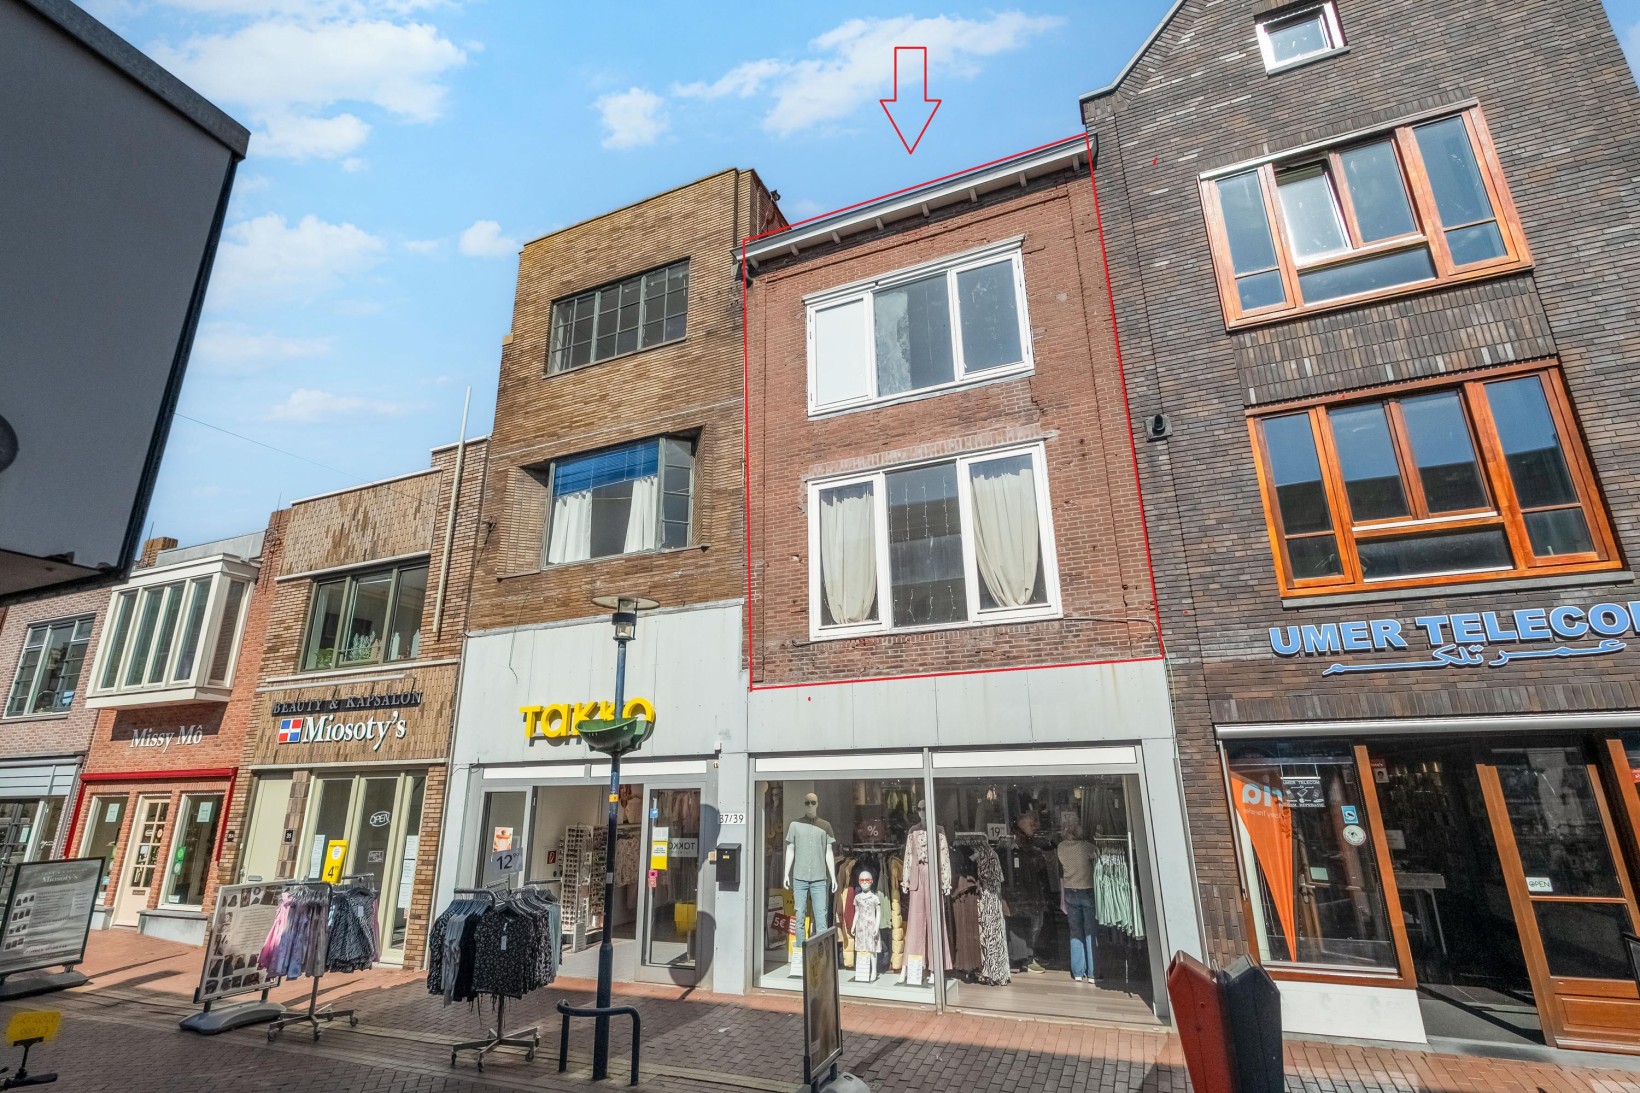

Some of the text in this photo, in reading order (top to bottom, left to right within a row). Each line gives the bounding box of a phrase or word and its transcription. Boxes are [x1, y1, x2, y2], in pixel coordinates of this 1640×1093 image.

[1268, 618, 1408, 656] UMER
[273, 691, 423, 714] BEAUTY & KAPSALON
[129, 725, 204, 753] Missy Mô
[302, 711, 407, 751] Miosoty's
[719, 814, 744, 824] 37/39
[496, 854, 513, 870] 12
